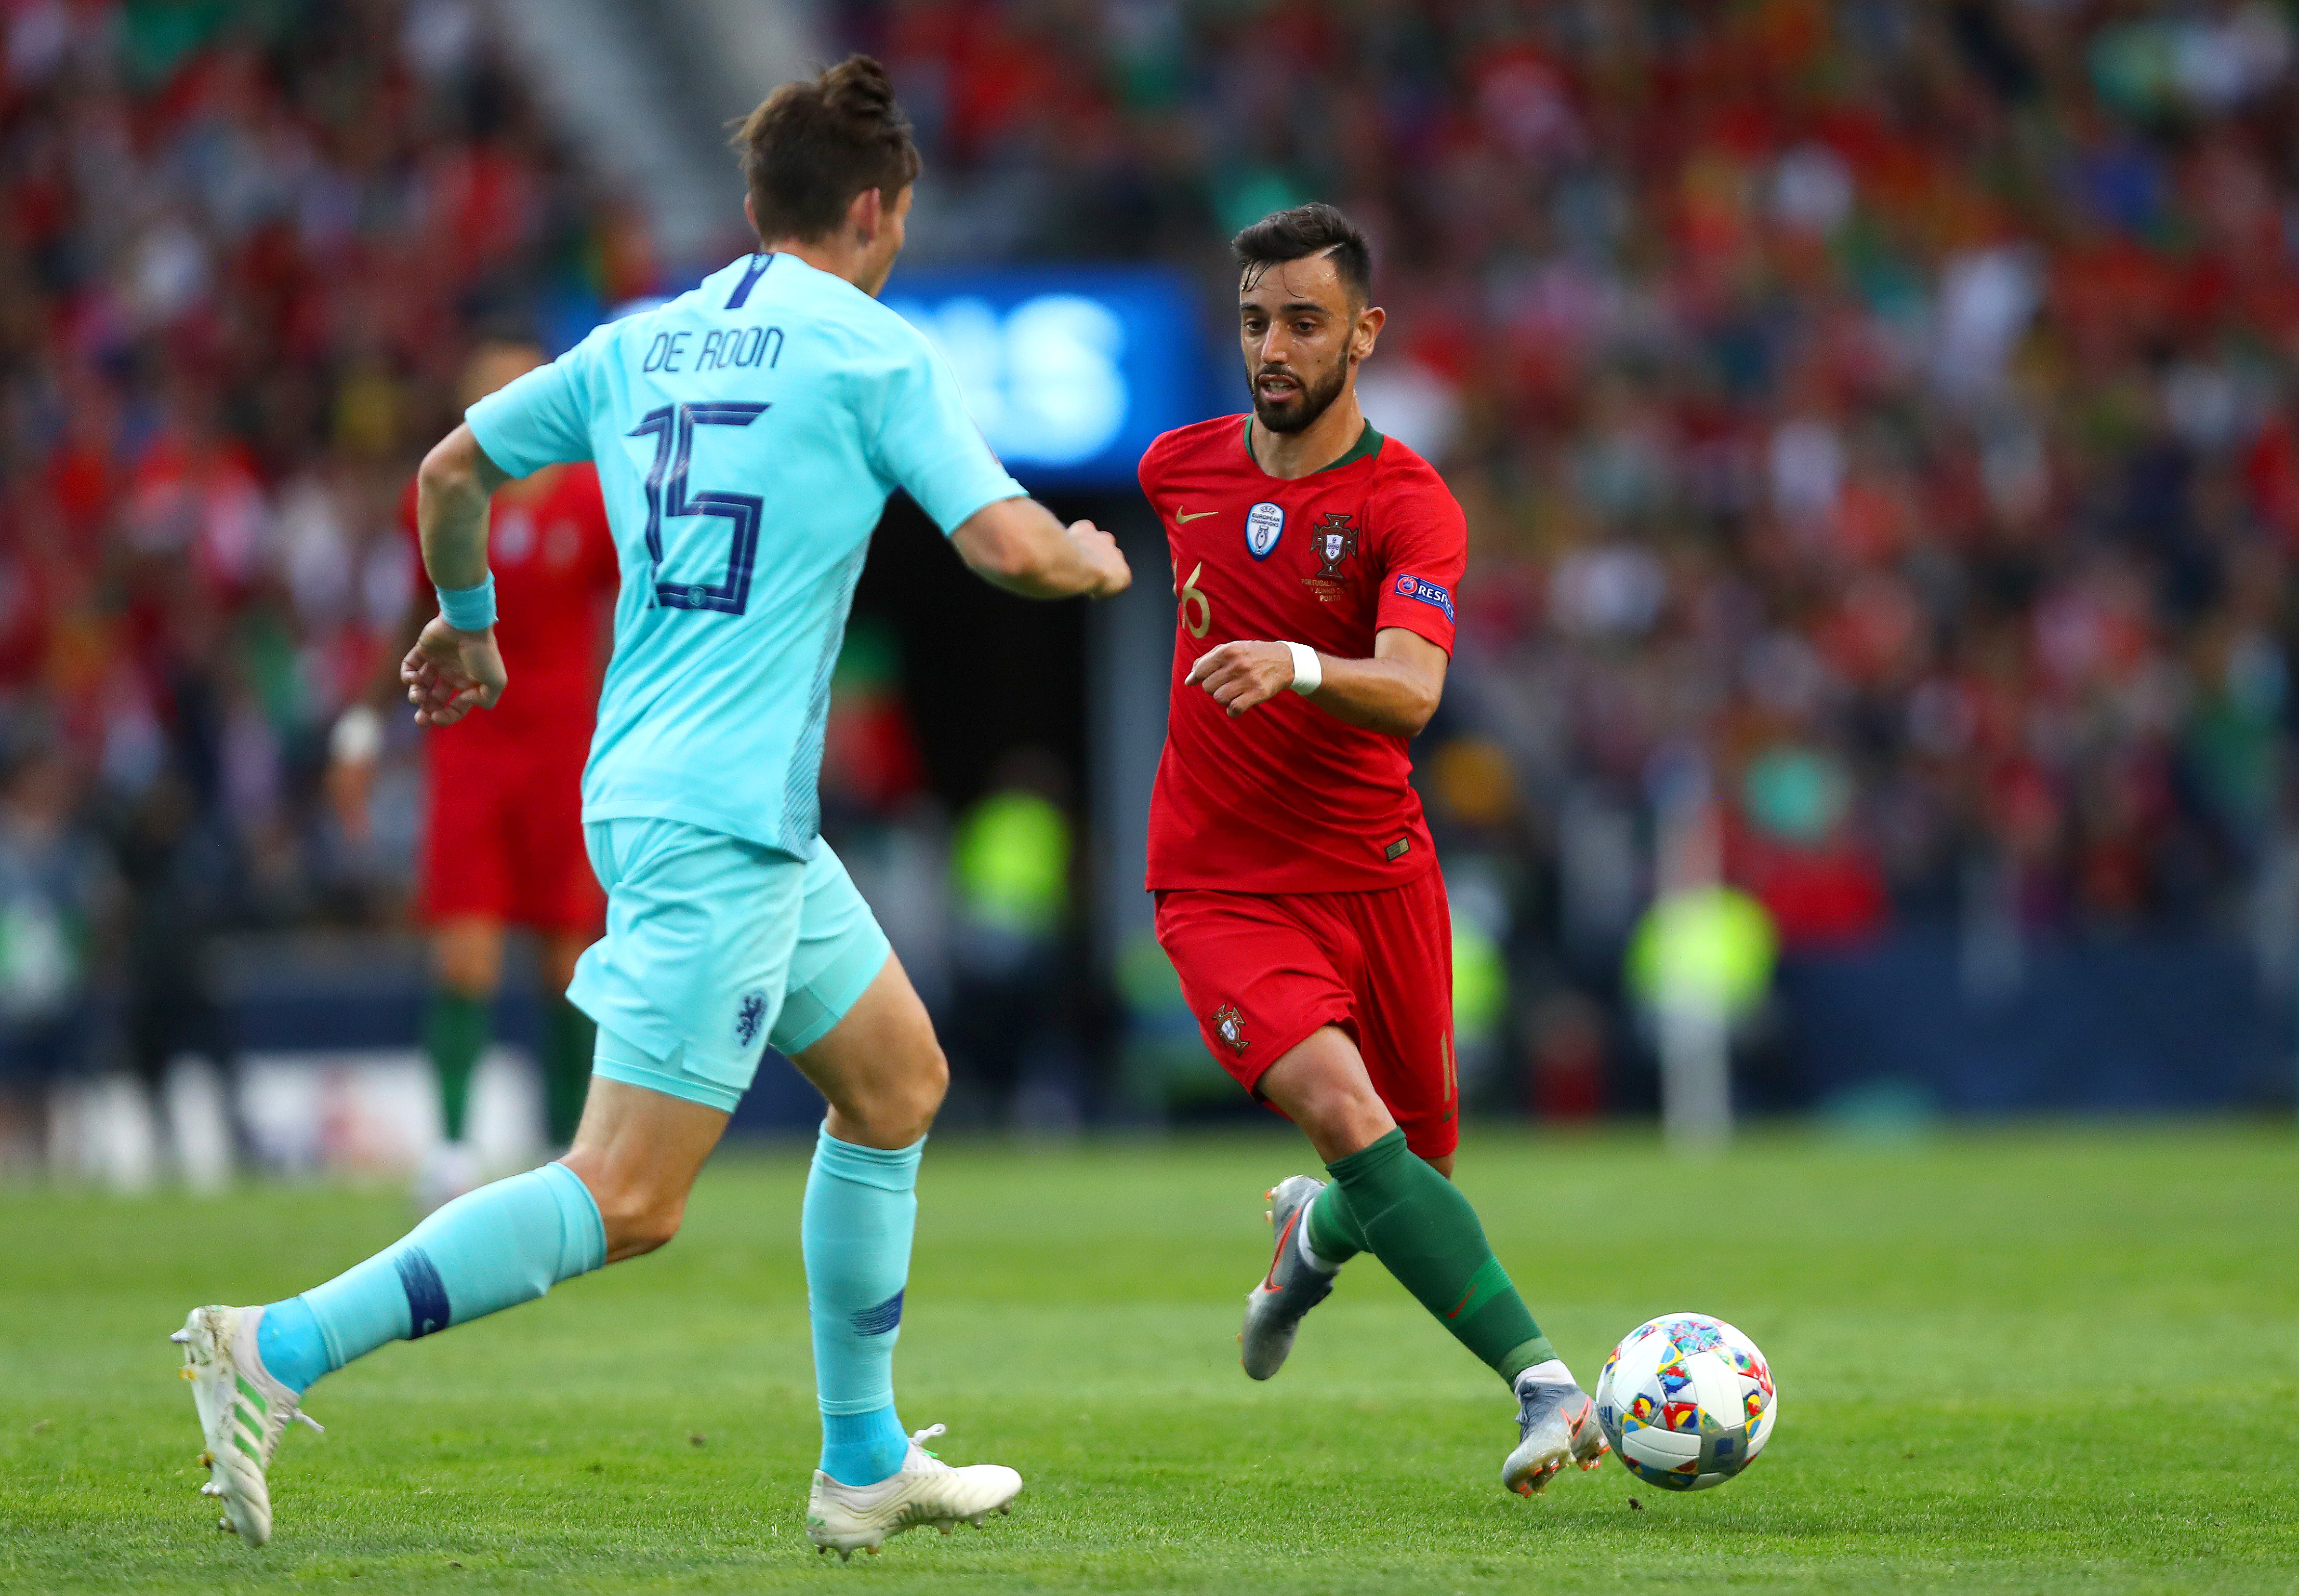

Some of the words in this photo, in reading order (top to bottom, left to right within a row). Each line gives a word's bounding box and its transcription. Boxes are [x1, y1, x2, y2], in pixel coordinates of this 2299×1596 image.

[643, 331, 693, 373] DE
[696, 326, 786, 371] ROON
[626, 401, 773, 616] 15
[1251, 512, 1280, 522] EUROPEAN
[1251, 518, 1278, 527] CHAMPIONS
